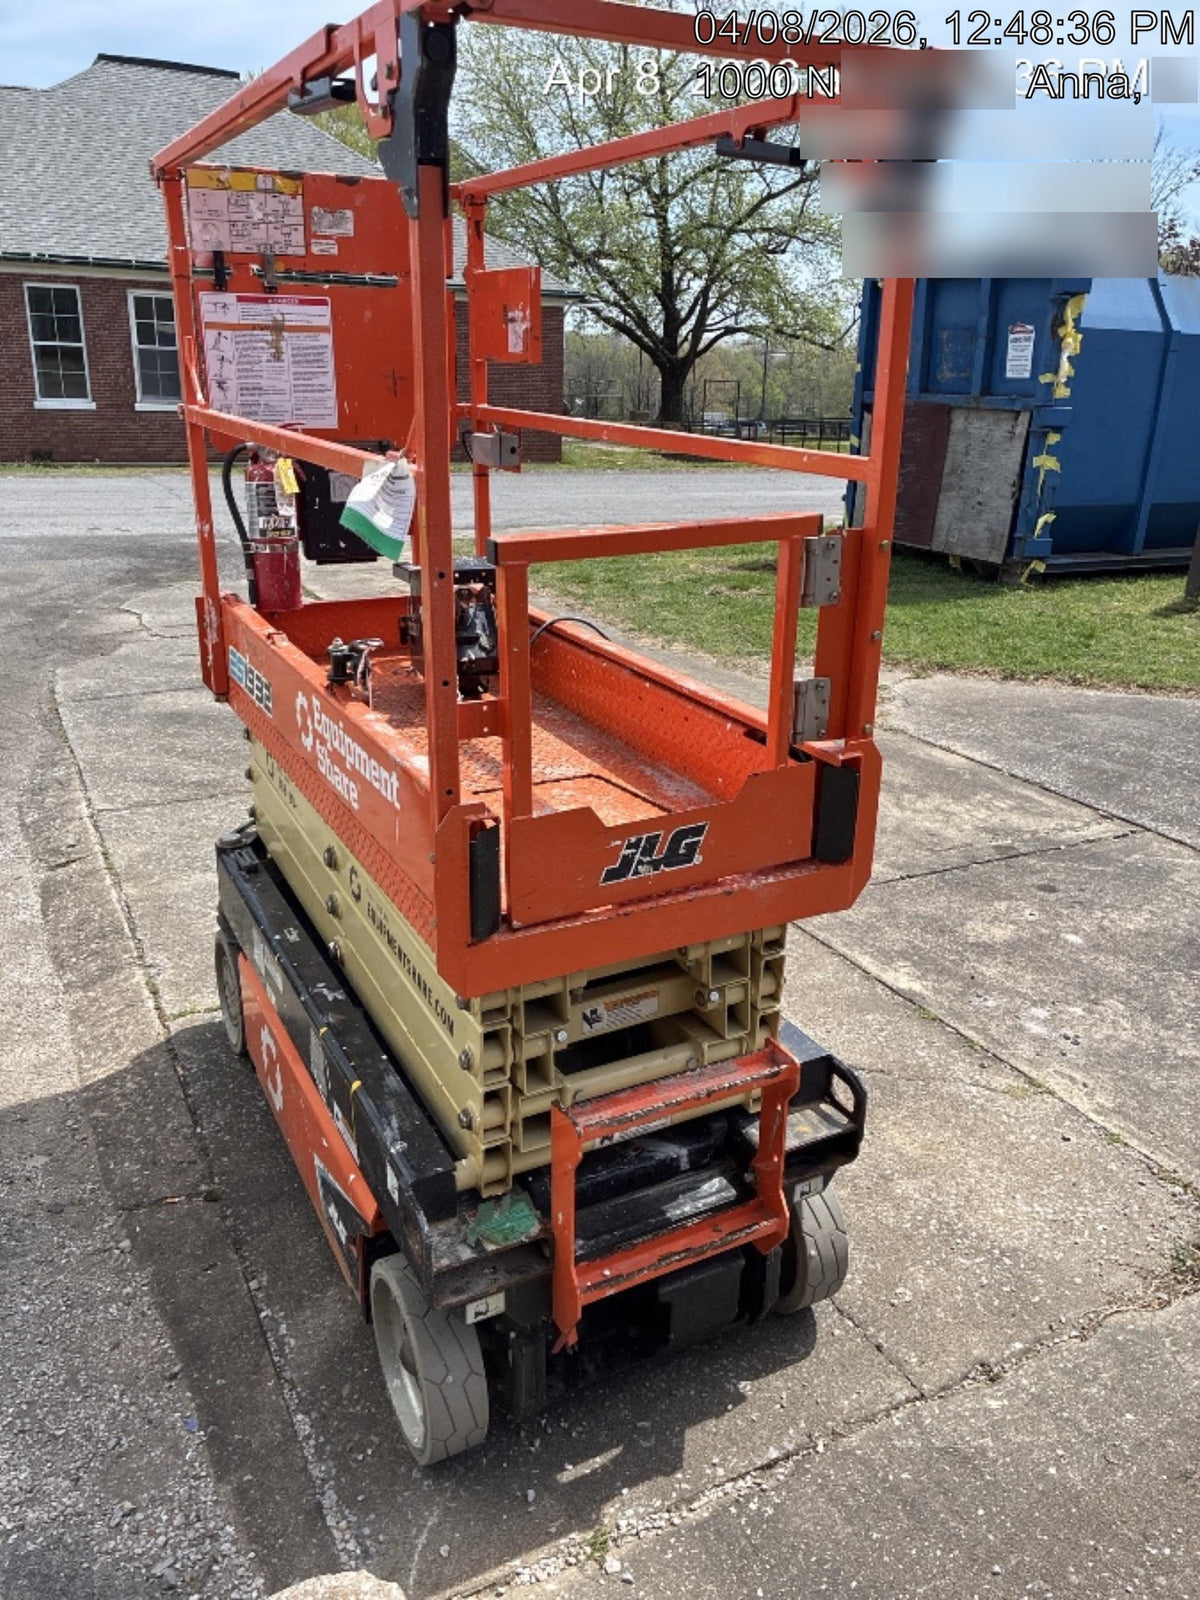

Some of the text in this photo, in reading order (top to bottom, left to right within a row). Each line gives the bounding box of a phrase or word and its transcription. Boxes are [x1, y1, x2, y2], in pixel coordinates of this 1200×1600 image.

[312, 695, 401, 811] Equipment
[315, 739, 360, 811] Share
[600, 821, 710, 886] JLG
